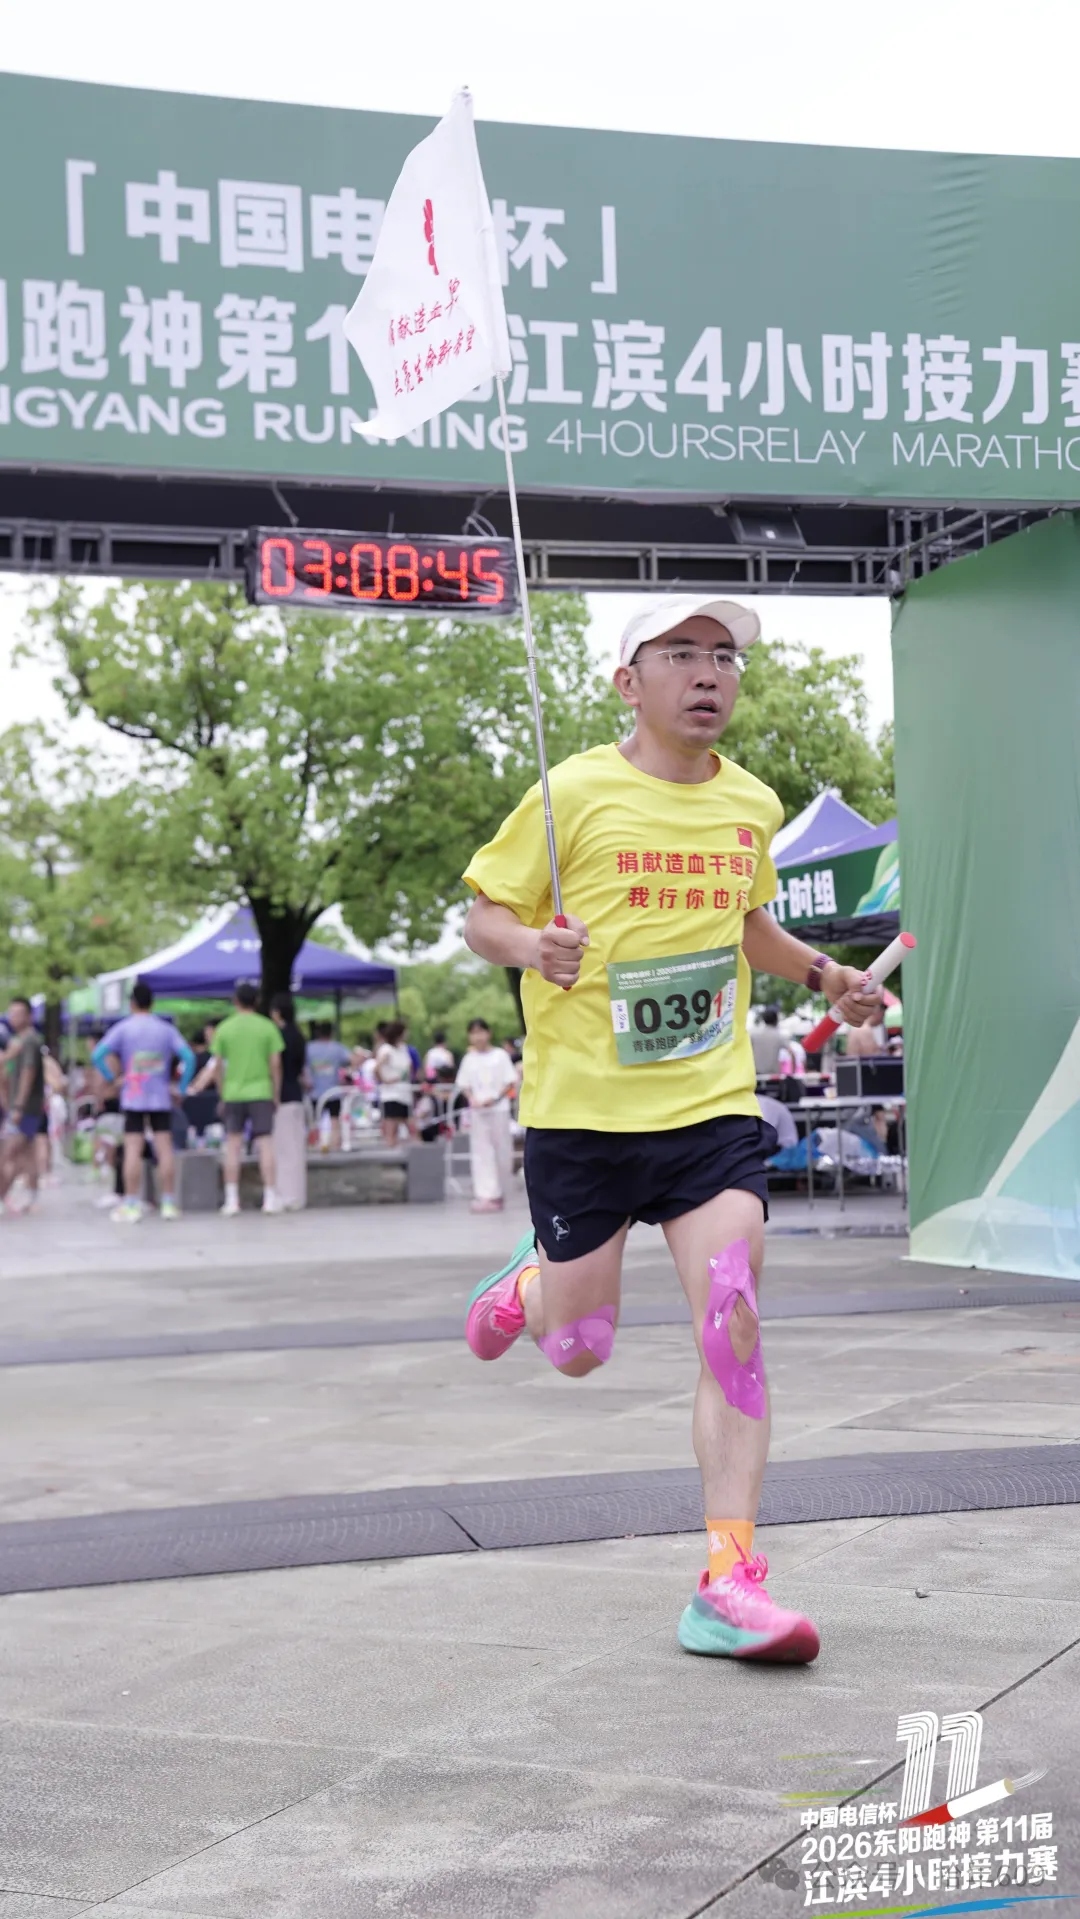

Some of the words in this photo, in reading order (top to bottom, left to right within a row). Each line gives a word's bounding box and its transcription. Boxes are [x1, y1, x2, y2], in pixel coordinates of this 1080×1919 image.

[0, 386, 226, 438] GYANG
[546, 418, 865, 465] 4HOURSRELAY
[261, 538, 504, 605] 03:08:45
[633, 989, 723, 1034] 0391
